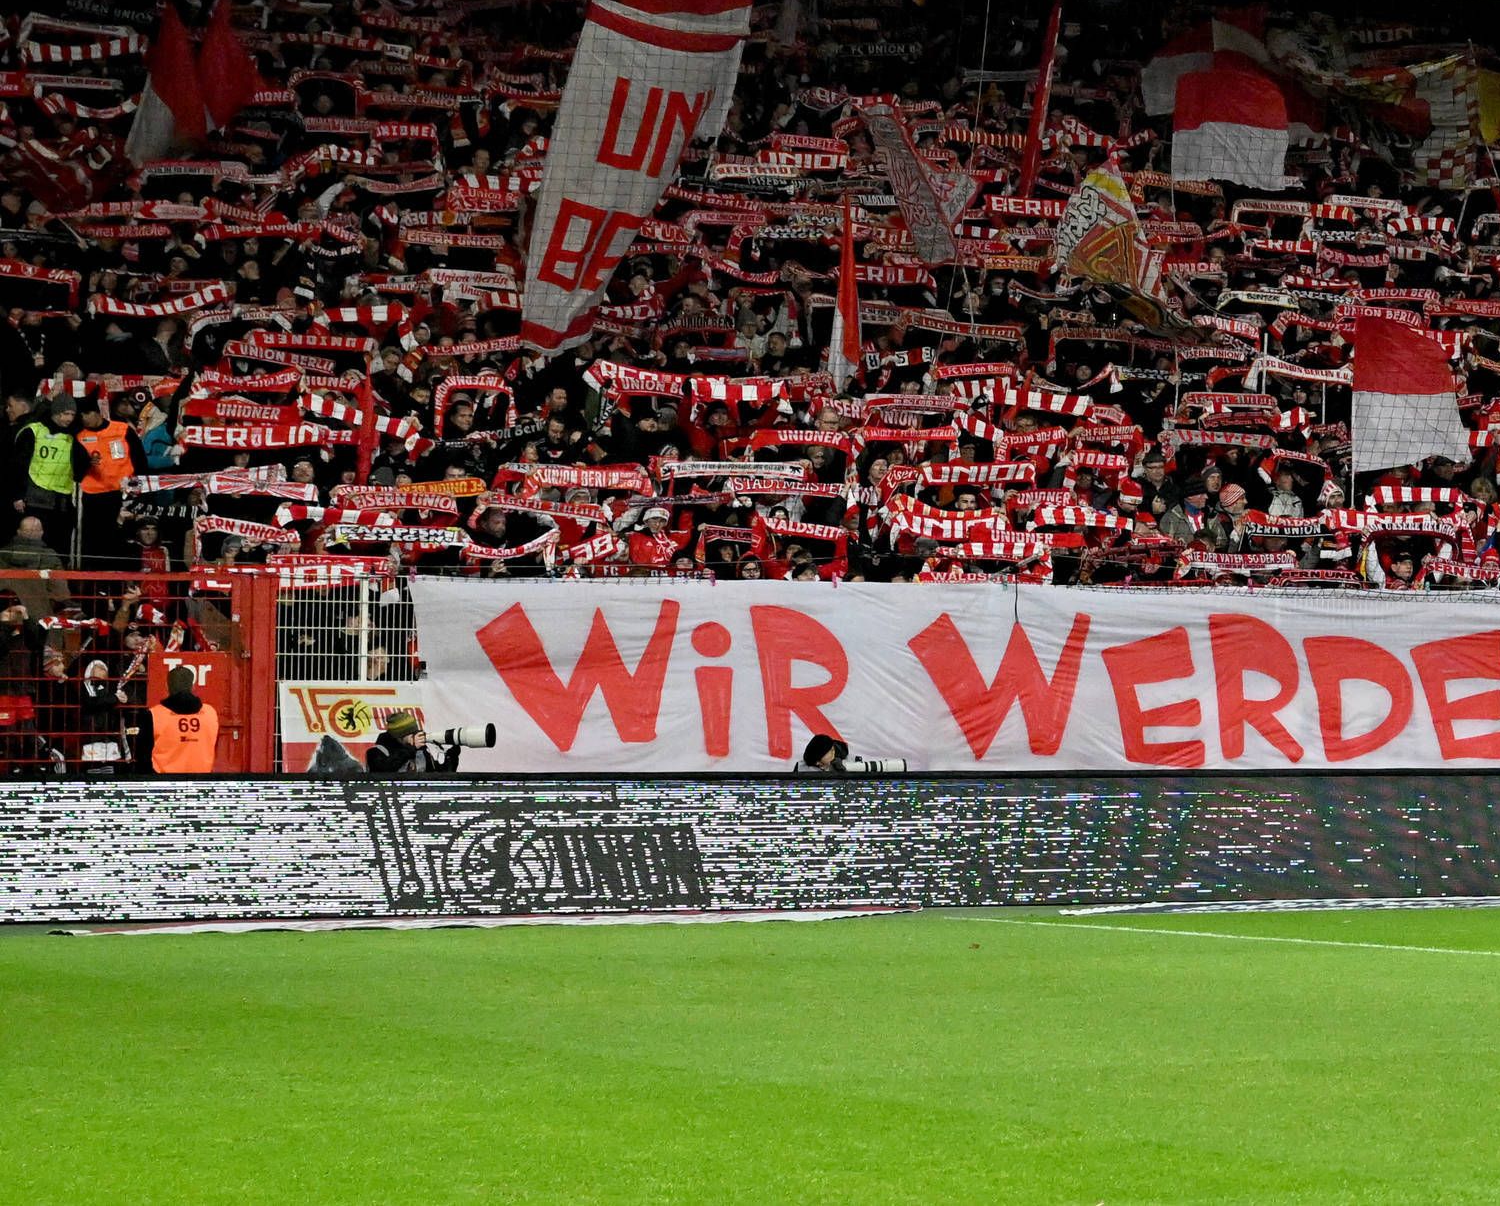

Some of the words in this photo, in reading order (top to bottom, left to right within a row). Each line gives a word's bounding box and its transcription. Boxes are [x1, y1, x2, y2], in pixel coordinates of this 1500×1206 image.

[961, 364, 989, 376] Union
[216, 403, 281, 420] UNIONER
[186, 426, 321, 447] BERLIN
[778, 429, 843, 447] UNIONER
[39, 444, 59, 460] 07
[924, 463, 1035, 485] UNION
[991, 530, 1053, 545] UNIONER
[163, 657, 212, 687] Tr
[178, 717, 200, 733] 69
